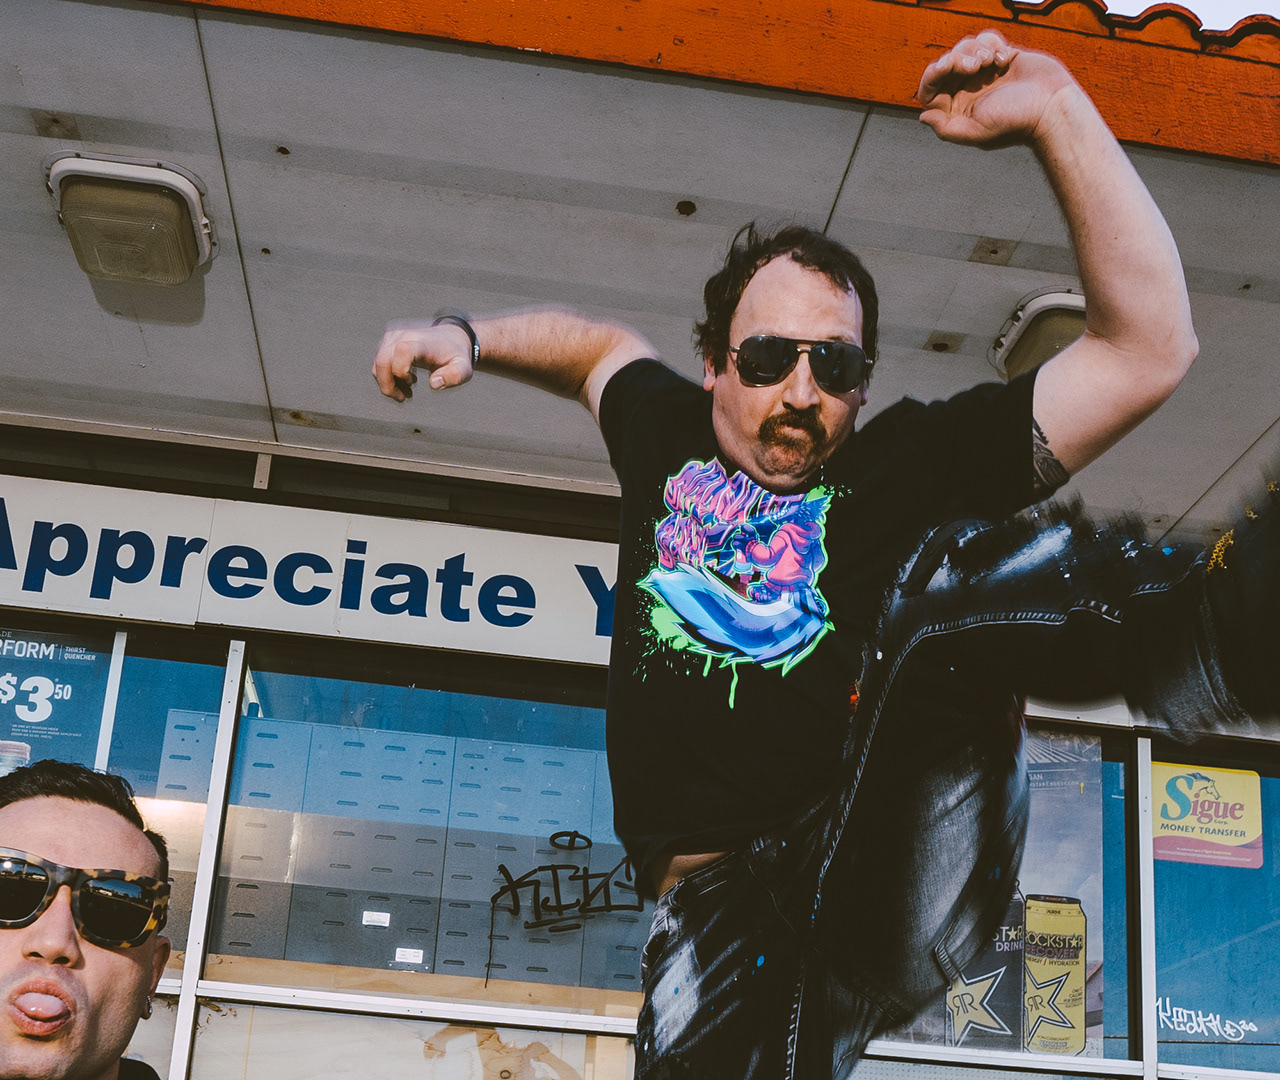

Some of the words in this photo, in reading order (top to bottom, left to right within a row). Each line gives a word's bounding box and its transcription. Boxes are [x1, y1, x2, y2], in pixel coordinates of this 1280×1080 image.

[63, 653, 97, 661] QUENCHER
[64, 646, 87, 654] THIRST
[1160, 775, 1245, 825] Sigue
[1160, 823, 1196, 833] MONEY
[1199, 826, 1246, 838] TRANSFER
[1025, 945, 1082, 960] RECOVERY
